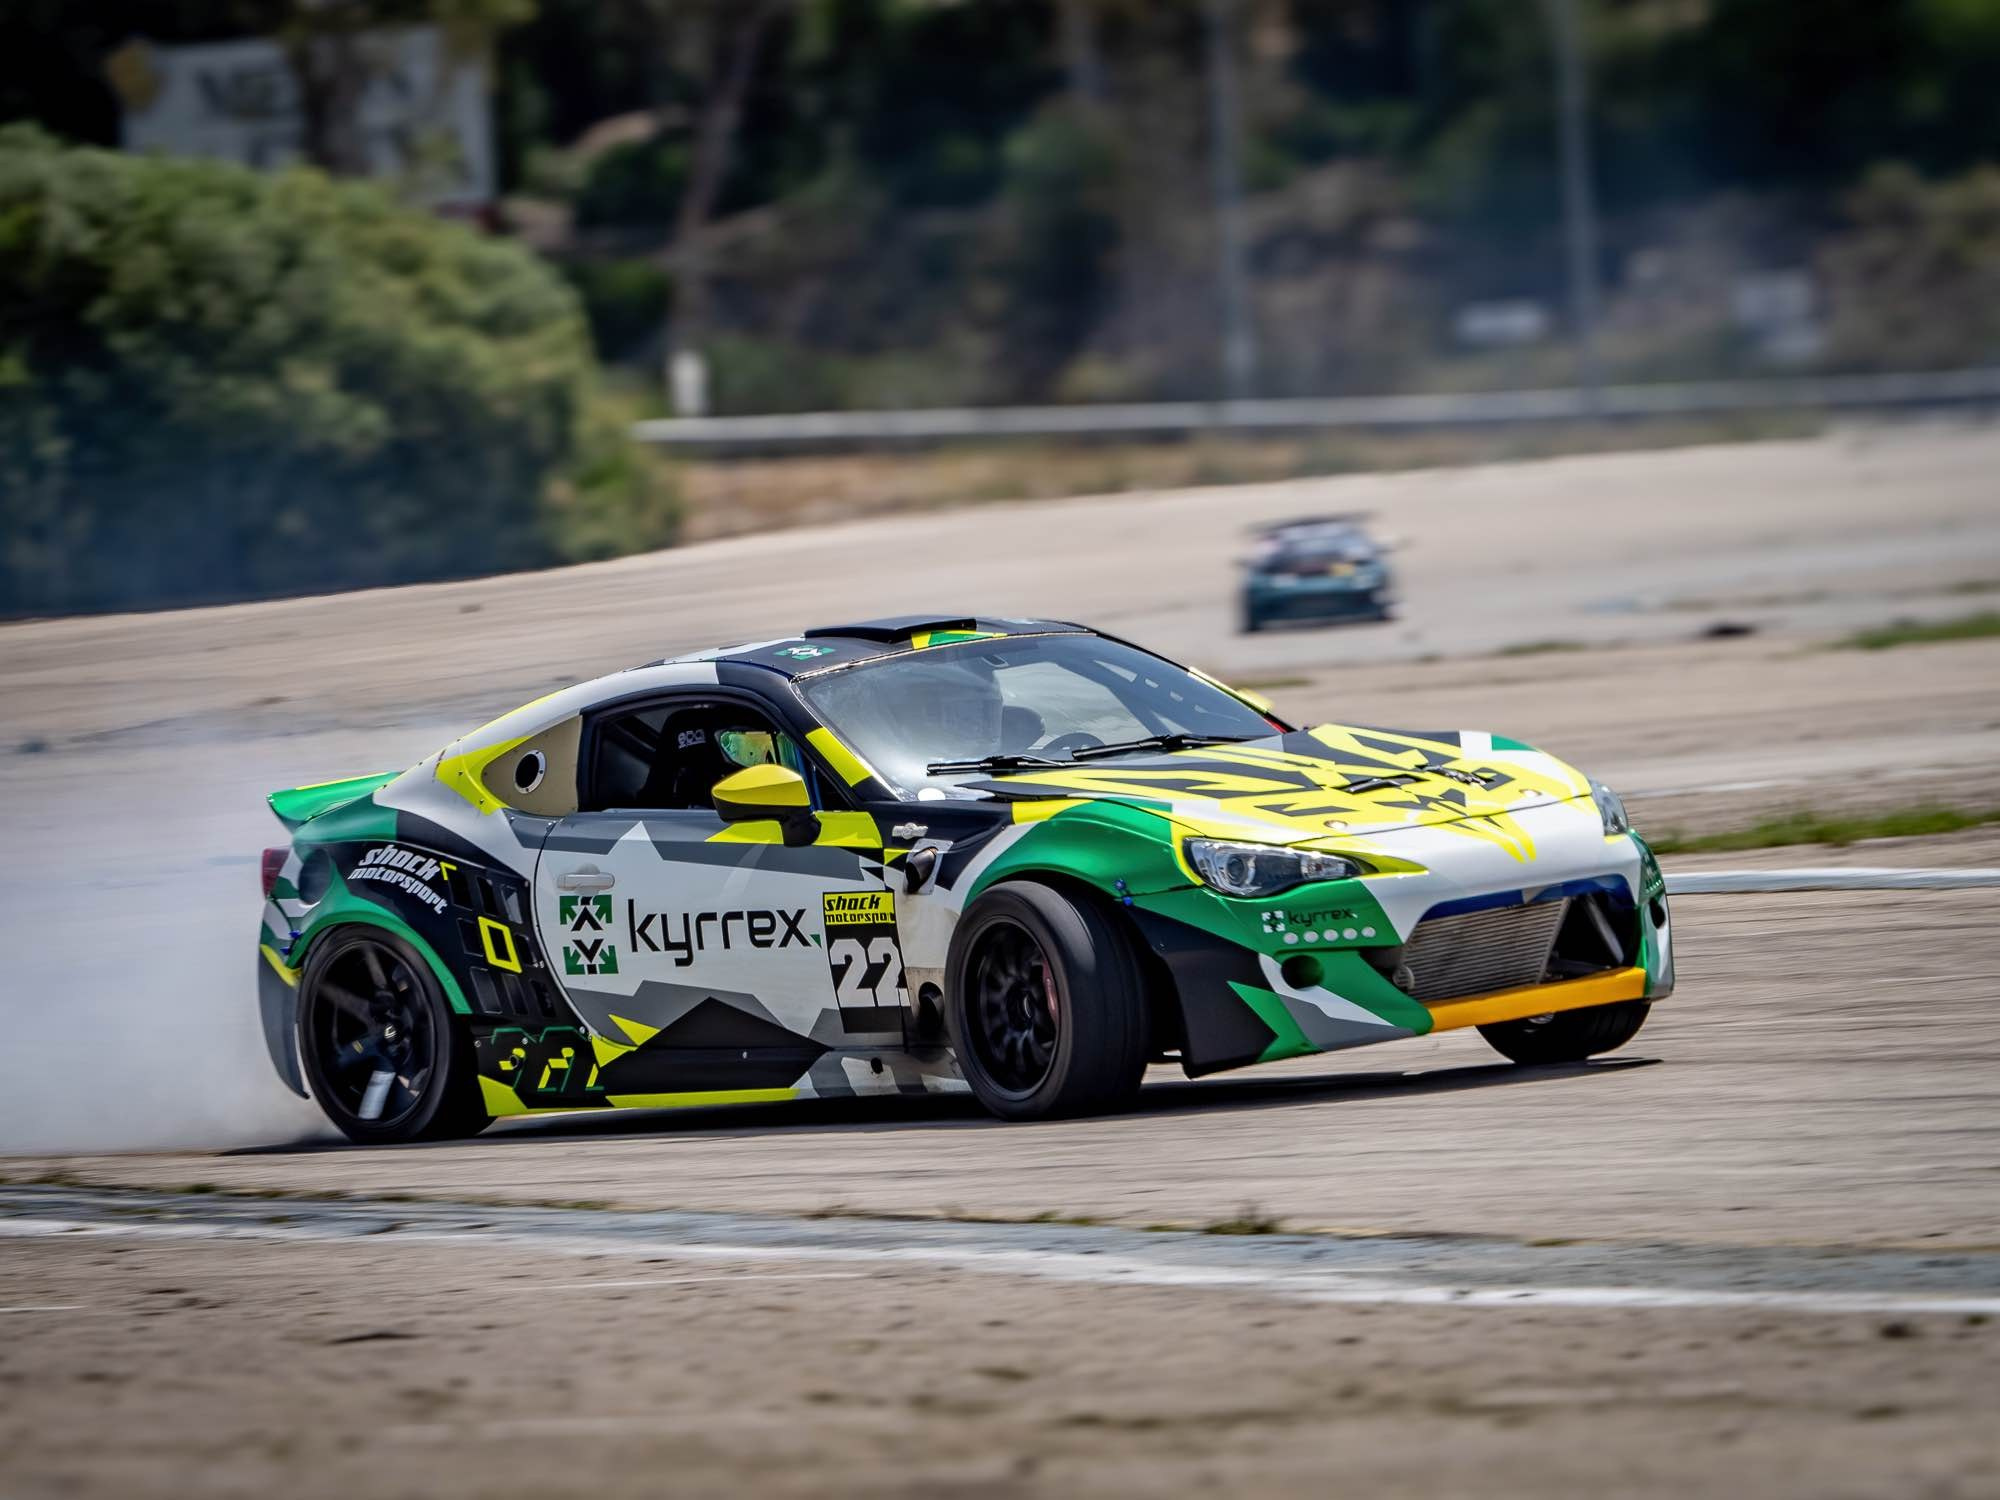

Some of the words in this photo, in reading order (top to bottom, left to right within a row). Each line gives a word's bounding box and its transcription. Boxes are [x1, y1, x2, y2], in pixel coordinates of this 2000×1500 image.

[358, 844, 441, 881] shock
[347, 866, 448, 914] motorsport
[824, 895, 881, 912] shock
[628, 898, 812, 967] kyrrex
[1287, 908, 1353, 927] kyrrex
[829, 936, 911, 1008] 22
